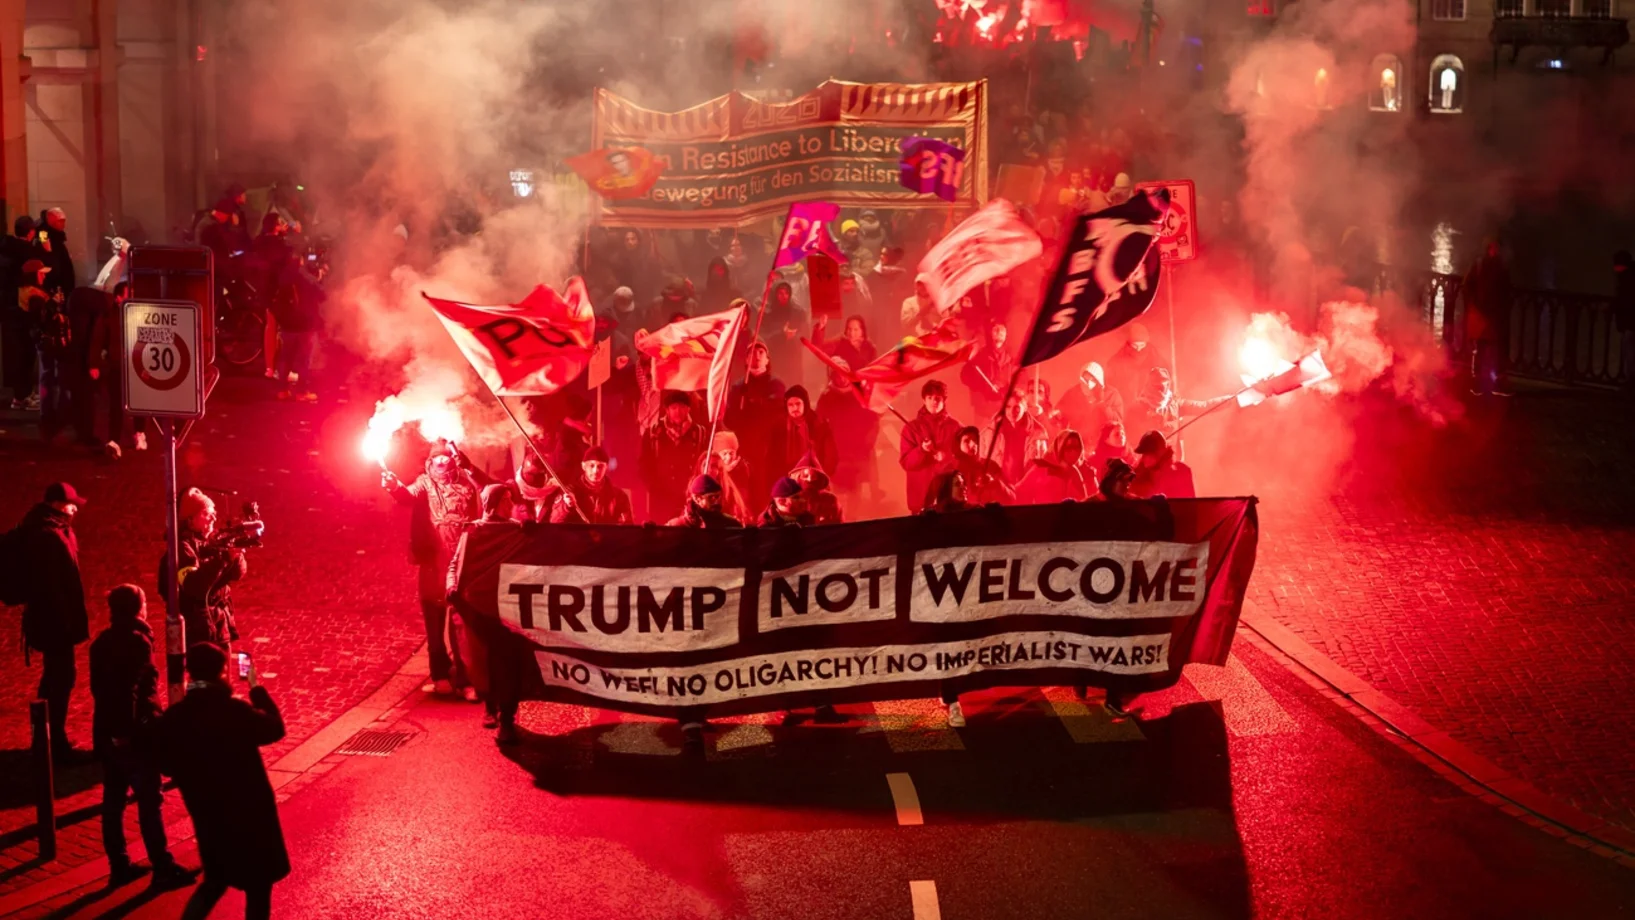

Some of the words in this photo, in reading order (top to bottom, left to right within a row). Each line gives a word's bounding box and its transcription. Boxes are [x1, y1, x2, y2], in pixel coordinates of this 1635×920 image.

[682, 144, 792, 170] Resistance
[798, 133, 821, 154] to
[640, 182, 748, 206] ewegung
[750, 175, 768, 195] für
[771, 169, 802, 188] den
[144, 312, 178, 326] ZONE
[149, 346, 174, 372] 30
[508, 583, 726, 635] TRUMP
[770, 569, 889, 618] NOT
[922, 557, 1197, 607] WELCOME
[552, 659, 590, 686] NO
[600, 671, 658, 695] WEF!
[667, 670, 707, 697] NO
[715, 656, 876, 692] OLIGARCHY!
[887, 652, 927, 673] NO
[936, 640, 1082, 671] IMPERIALIST
[1087, 643, 1163, 666] WARS!
